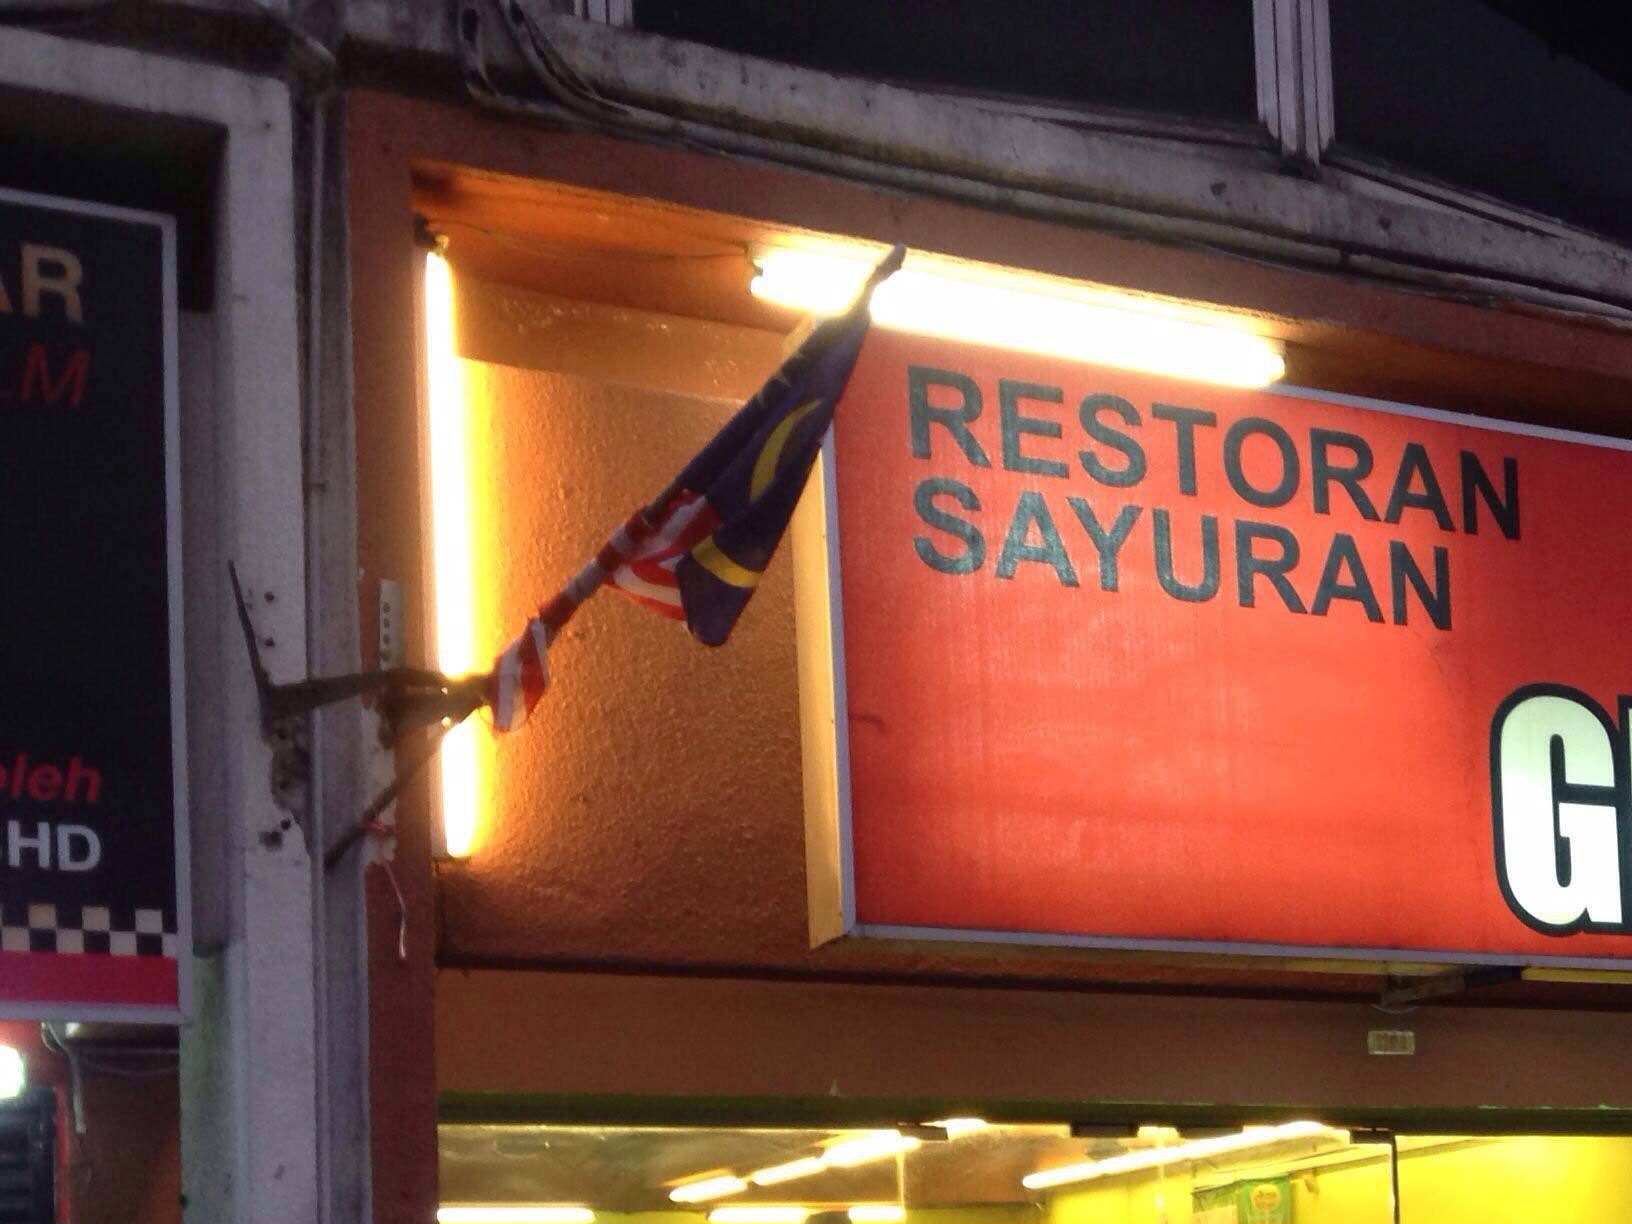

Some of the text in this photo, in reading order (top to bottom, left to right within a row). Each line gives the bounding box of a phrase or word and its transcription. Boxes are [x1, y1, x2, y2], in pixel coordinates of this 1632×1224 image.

[0, 341, 90, 408] M
[906, 365, 1521, 541] RESTORAN
[912, 476, 1453, 632] SAYURAN
[0, 751, 102, 803] leh
[0, 819, 103, 872] HD
